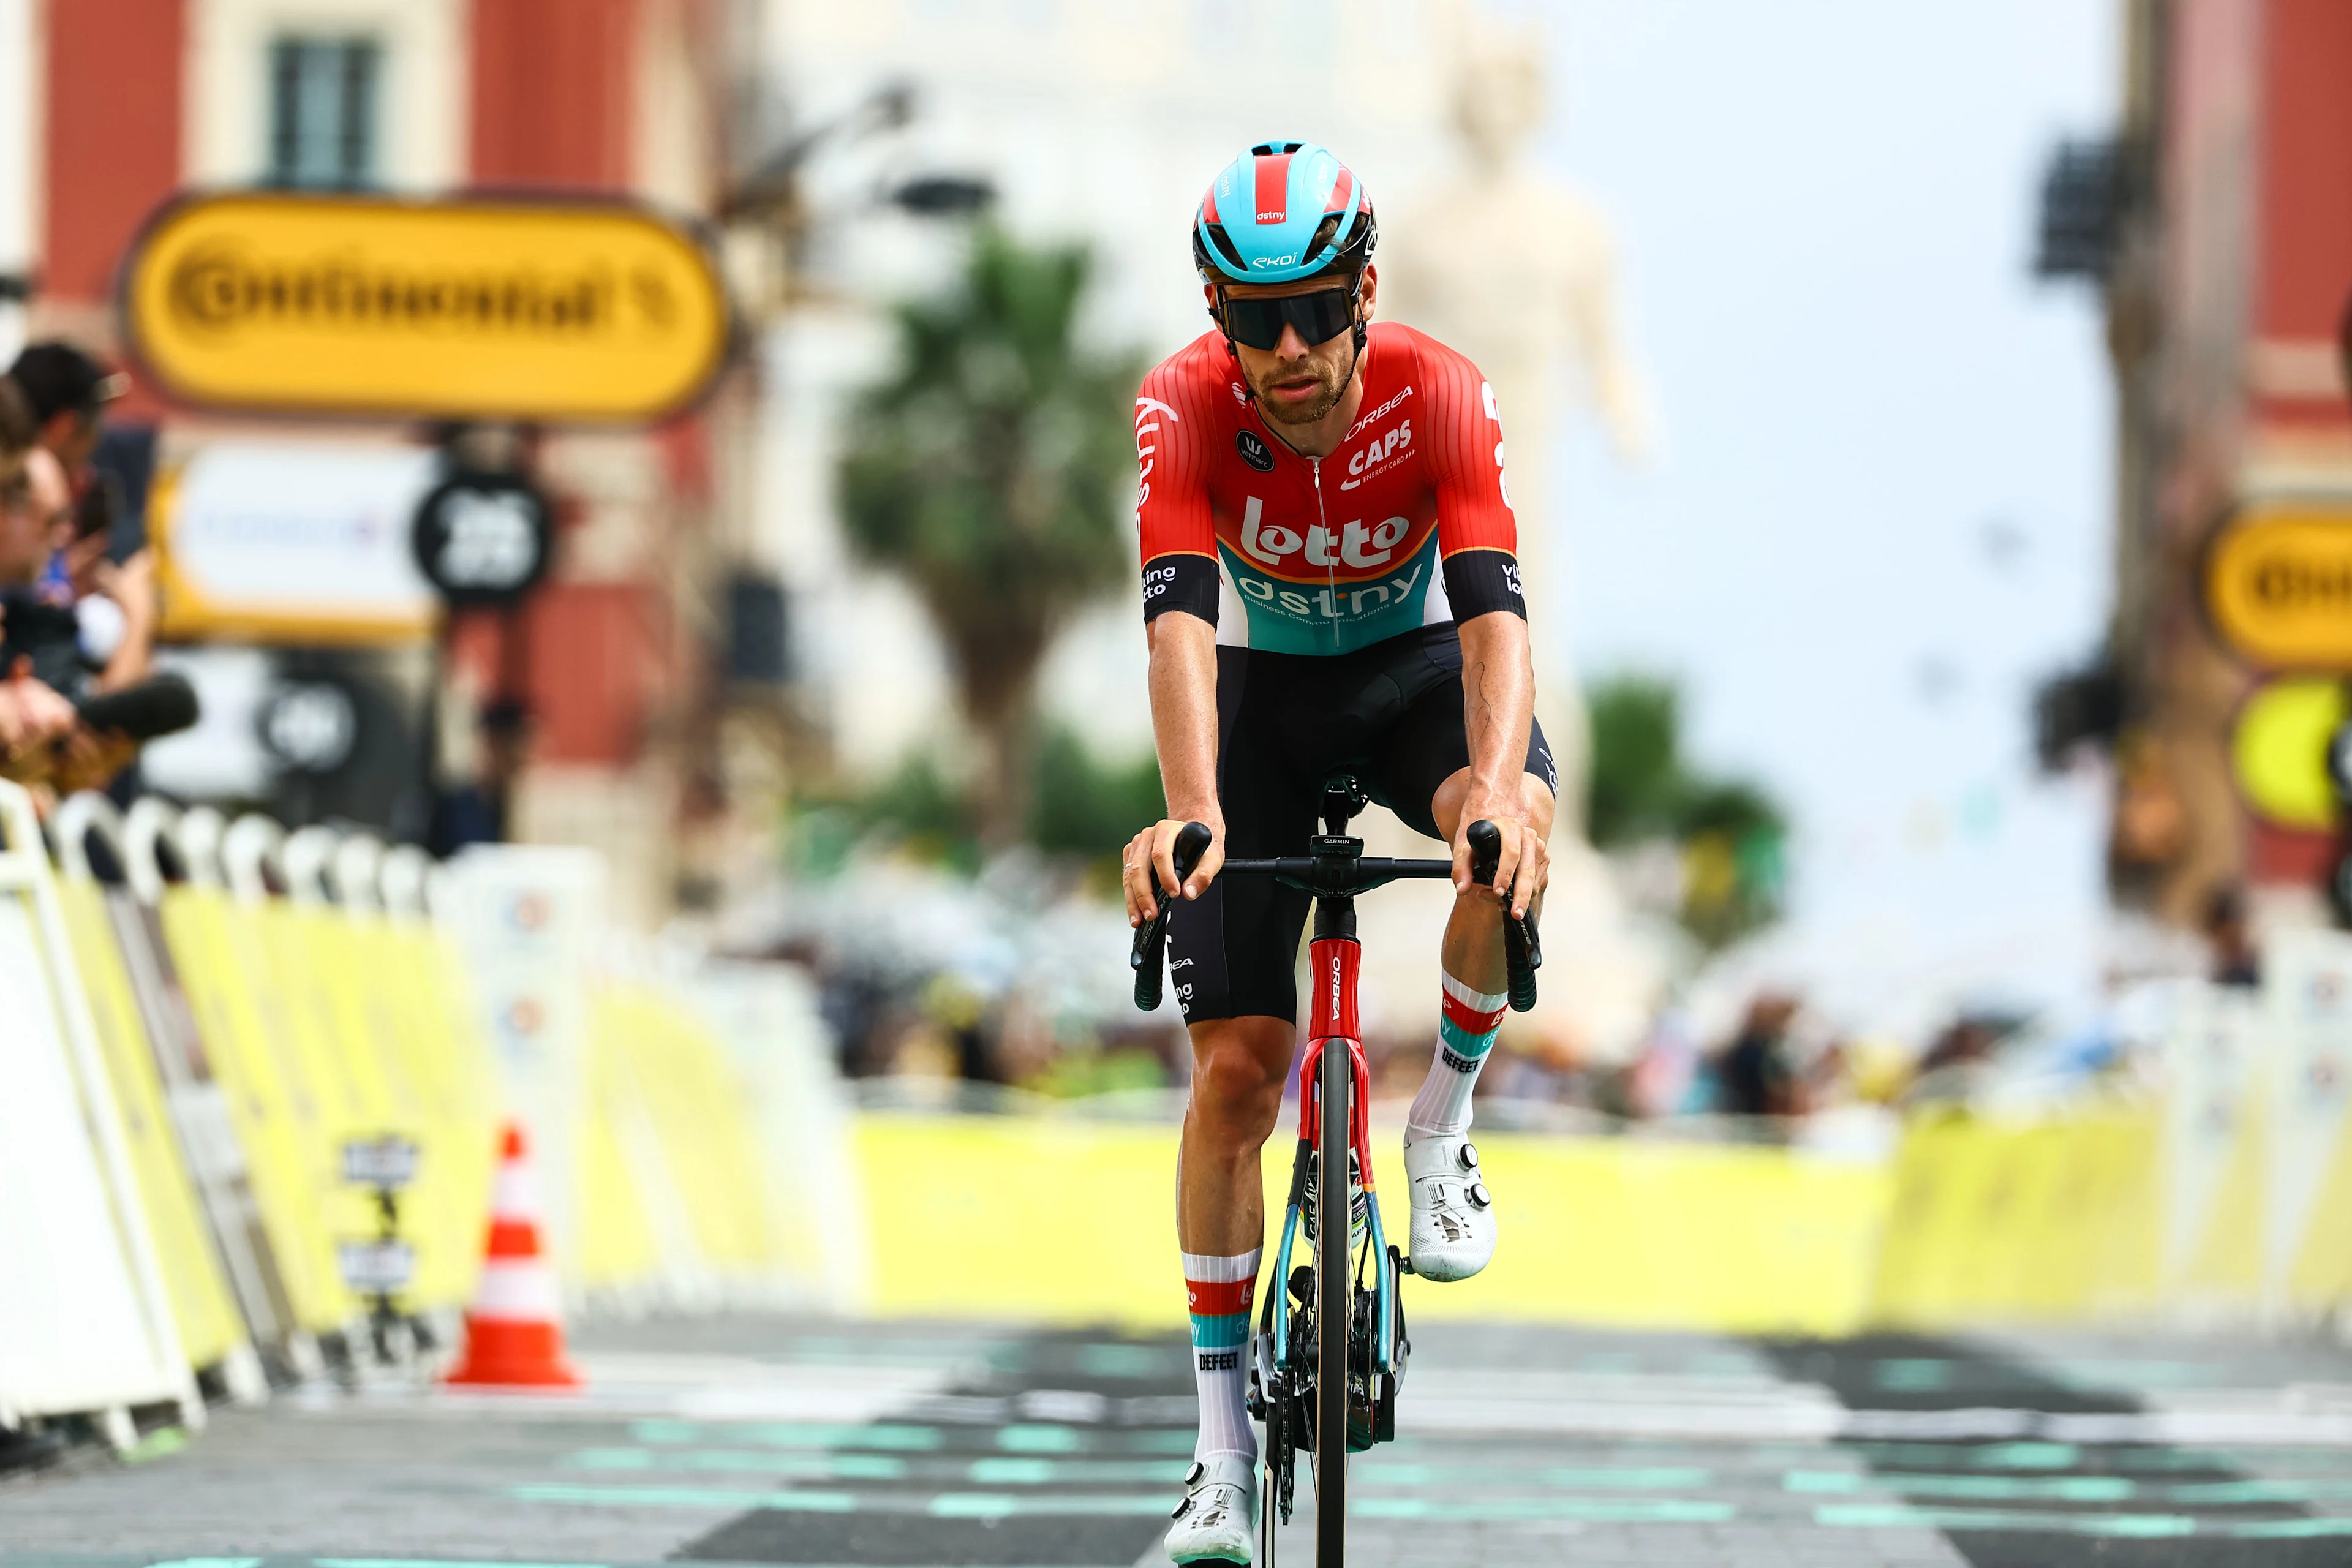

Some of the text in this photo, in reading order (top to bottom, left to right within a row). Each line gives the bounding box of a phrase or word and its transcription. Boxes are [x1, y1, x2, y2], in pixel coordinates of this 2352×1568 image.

[1220, 175, 1231, 198] dstny
[1256, 211, 1286, 221] dstny
[1344, 385, 1414, 442] ORBEA
[1241, 448, 1268, 469] vermarc
[1348, 418, 1412, 476] CAPS
[1363, 456, 1404, 483] ENERGY CARD
[1238, 563, 1422, 618] dstny
[1244, 594, 1286, 616] Business
[1332, 957, 1341, 1021] ORBEA
[1441, 1046, 1480, 1073] DEFEET
[1199, 1351, 1238, 1371] DEFEET
